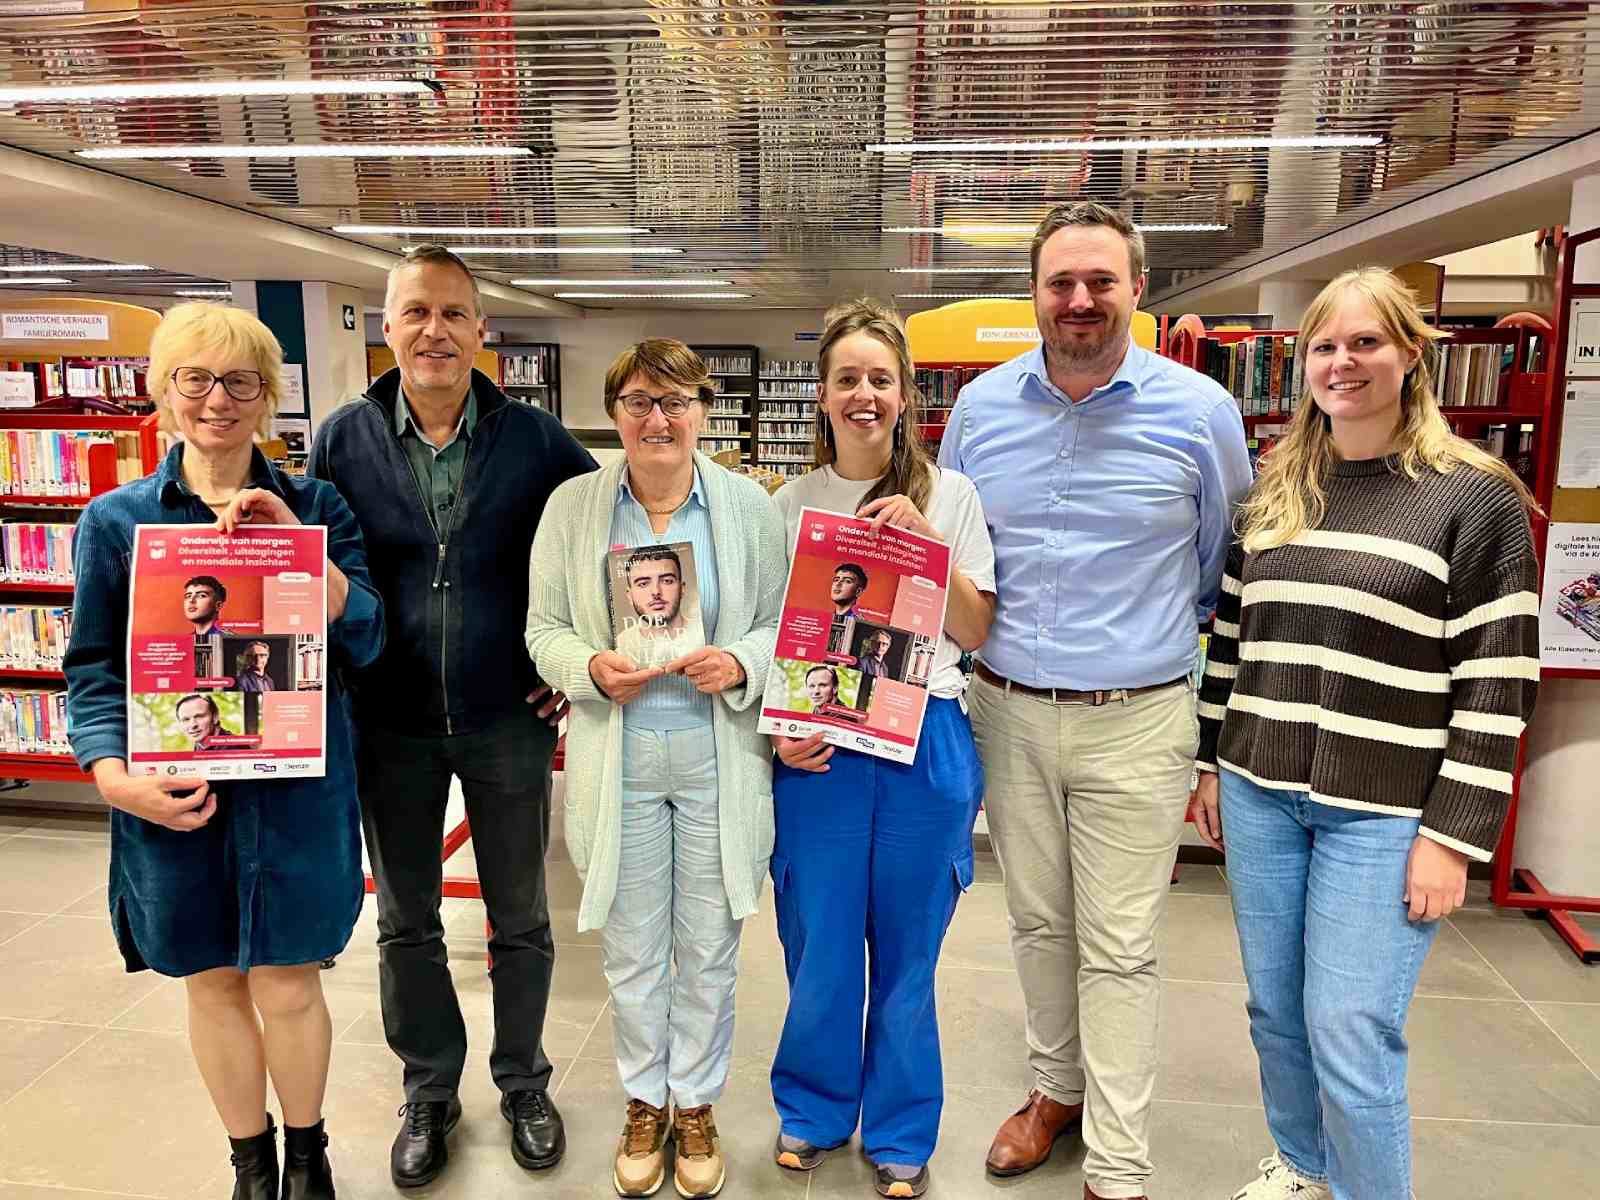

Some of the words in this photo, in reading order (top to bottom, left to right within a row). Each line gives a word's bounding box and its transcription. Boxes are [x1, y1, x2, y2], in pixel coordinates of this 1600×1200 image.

[6, 316, 60, 324] ROMANTISCHE
[62, 316, 103, 324] VERHALEN
[1578, 346, 1594, 357] IN
[180, 536, 229, 547] Onderwijs
[251, 538, 294, 548] morgen:
[178, 547, 229, 555] Diversiteit
[234, 547, 296, 559] uitdagingen
[182, 558, 194, 566] en
[196, 557, 243, 566] mondiale
[245, 557, 291, 566] inzichten
